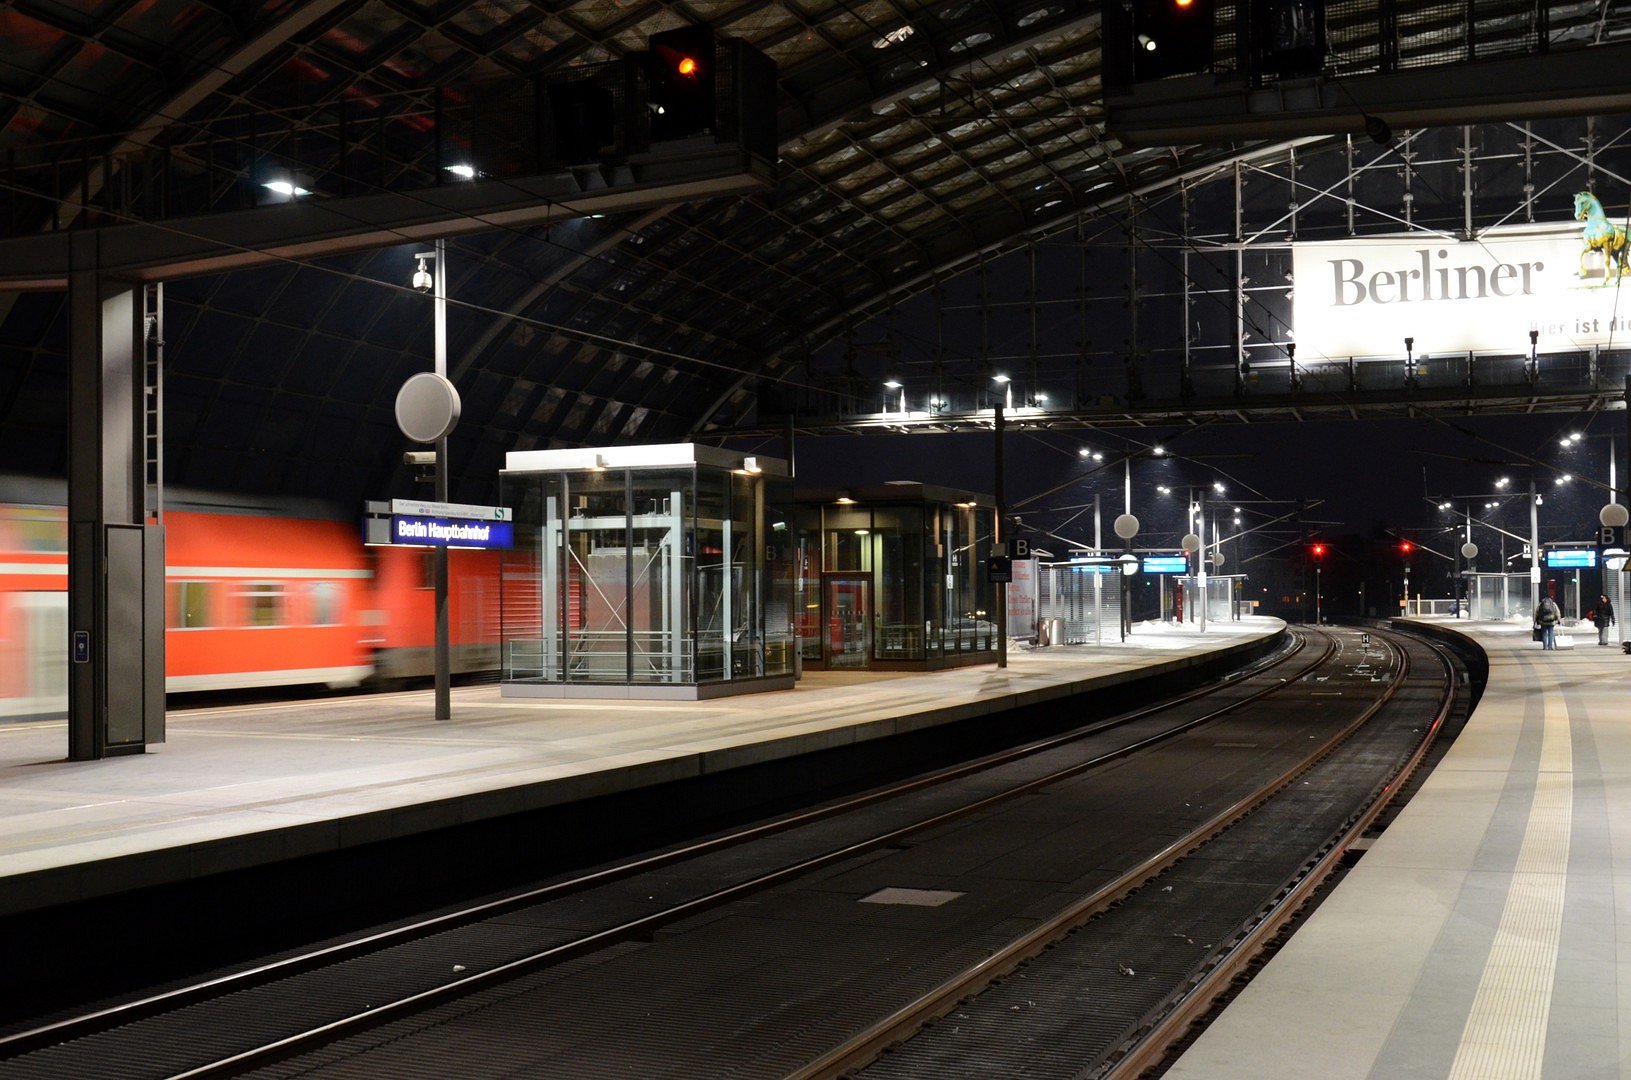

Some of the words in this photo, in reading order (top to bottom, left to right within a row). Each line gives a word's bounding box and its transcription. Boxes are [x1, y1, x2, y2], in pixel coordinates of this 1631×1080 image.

[1328, 249, 1544, 306] Berliner
[1575, 318, 1599, 334] ist
[398, 520, 427, 537] Berlin
[428, 523, 490, 542] Hauptbahnhof
[1601, 527, 1615, 545] B
[1016, 539, 1028, 556] B
[1523, 545, 1530, 554] H
[1362, 634, 1369, 643] H
